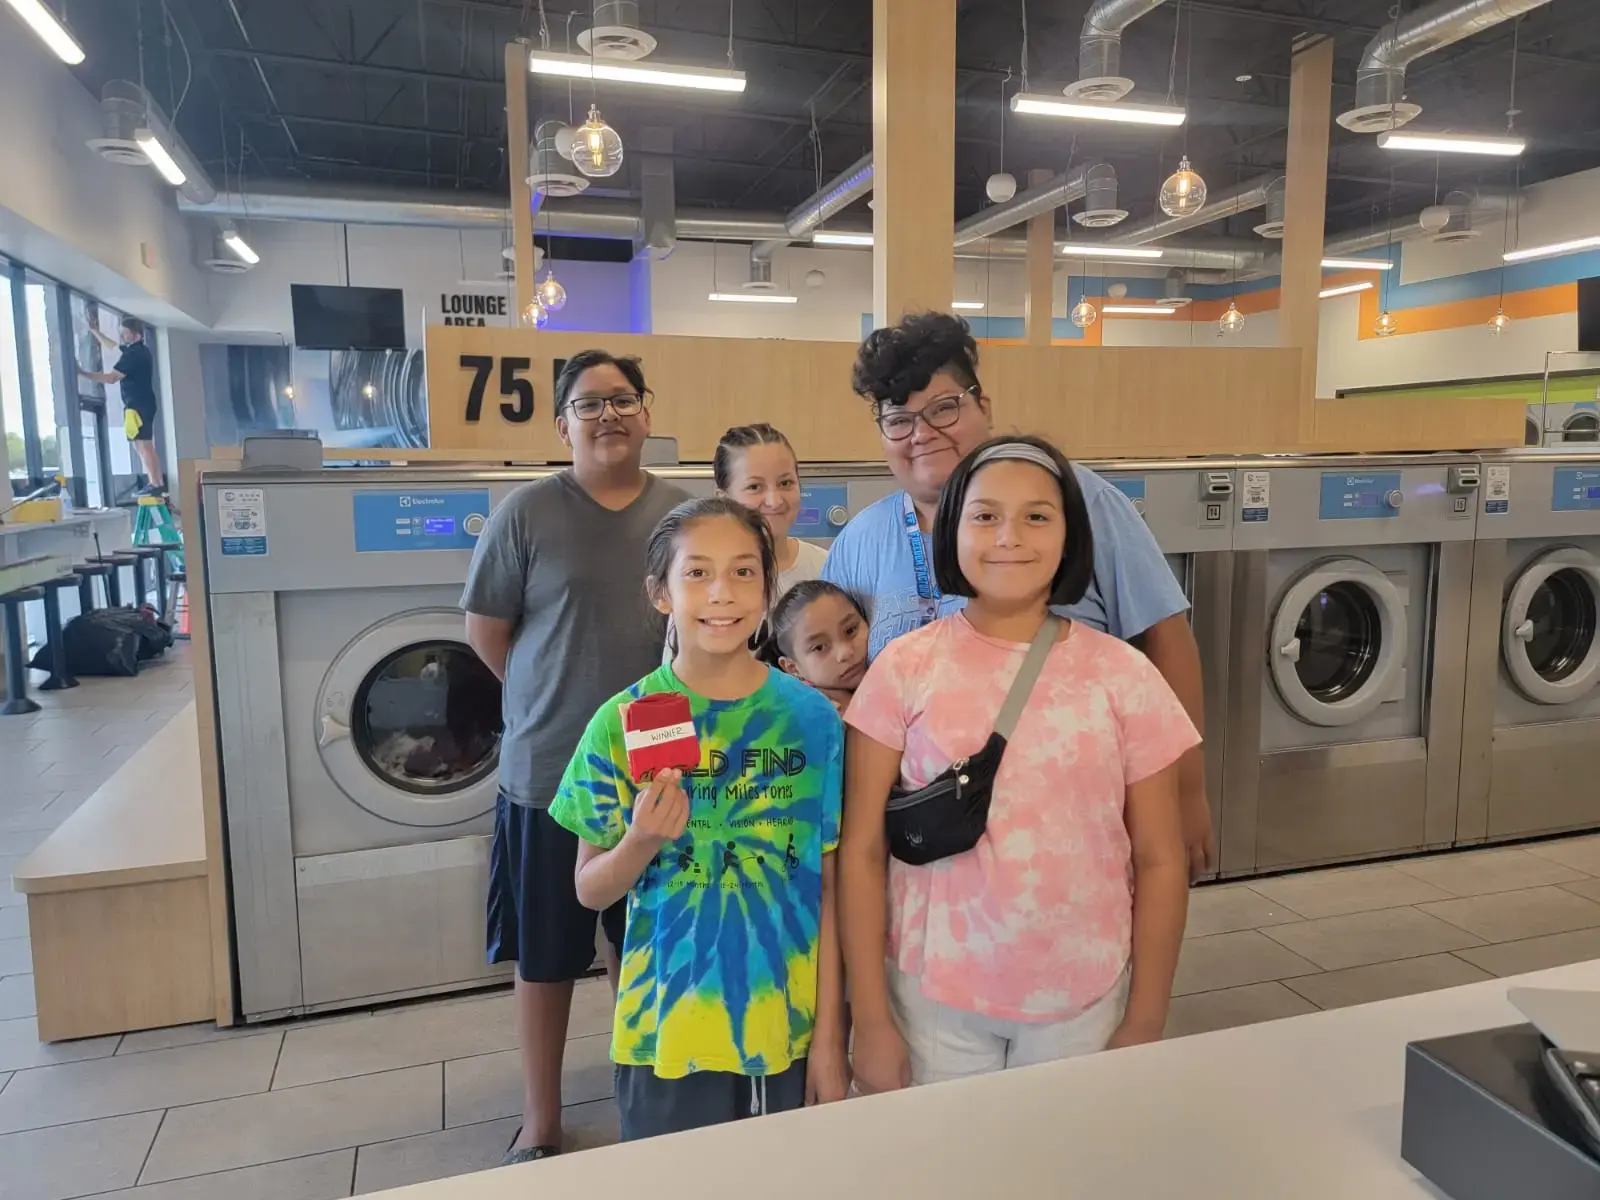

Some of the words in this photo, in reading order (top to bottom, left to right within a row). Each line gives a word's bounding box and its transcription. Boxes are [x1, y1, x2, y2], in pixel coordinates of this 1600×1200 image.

[441, 294, 506, 316] LOUNGE
[460, 355, 534, 423] 75
[651, 726, 684, 741] WINNER
[742, 747, 807, 778] FIND
[729, 818, 756, 829] VISION
